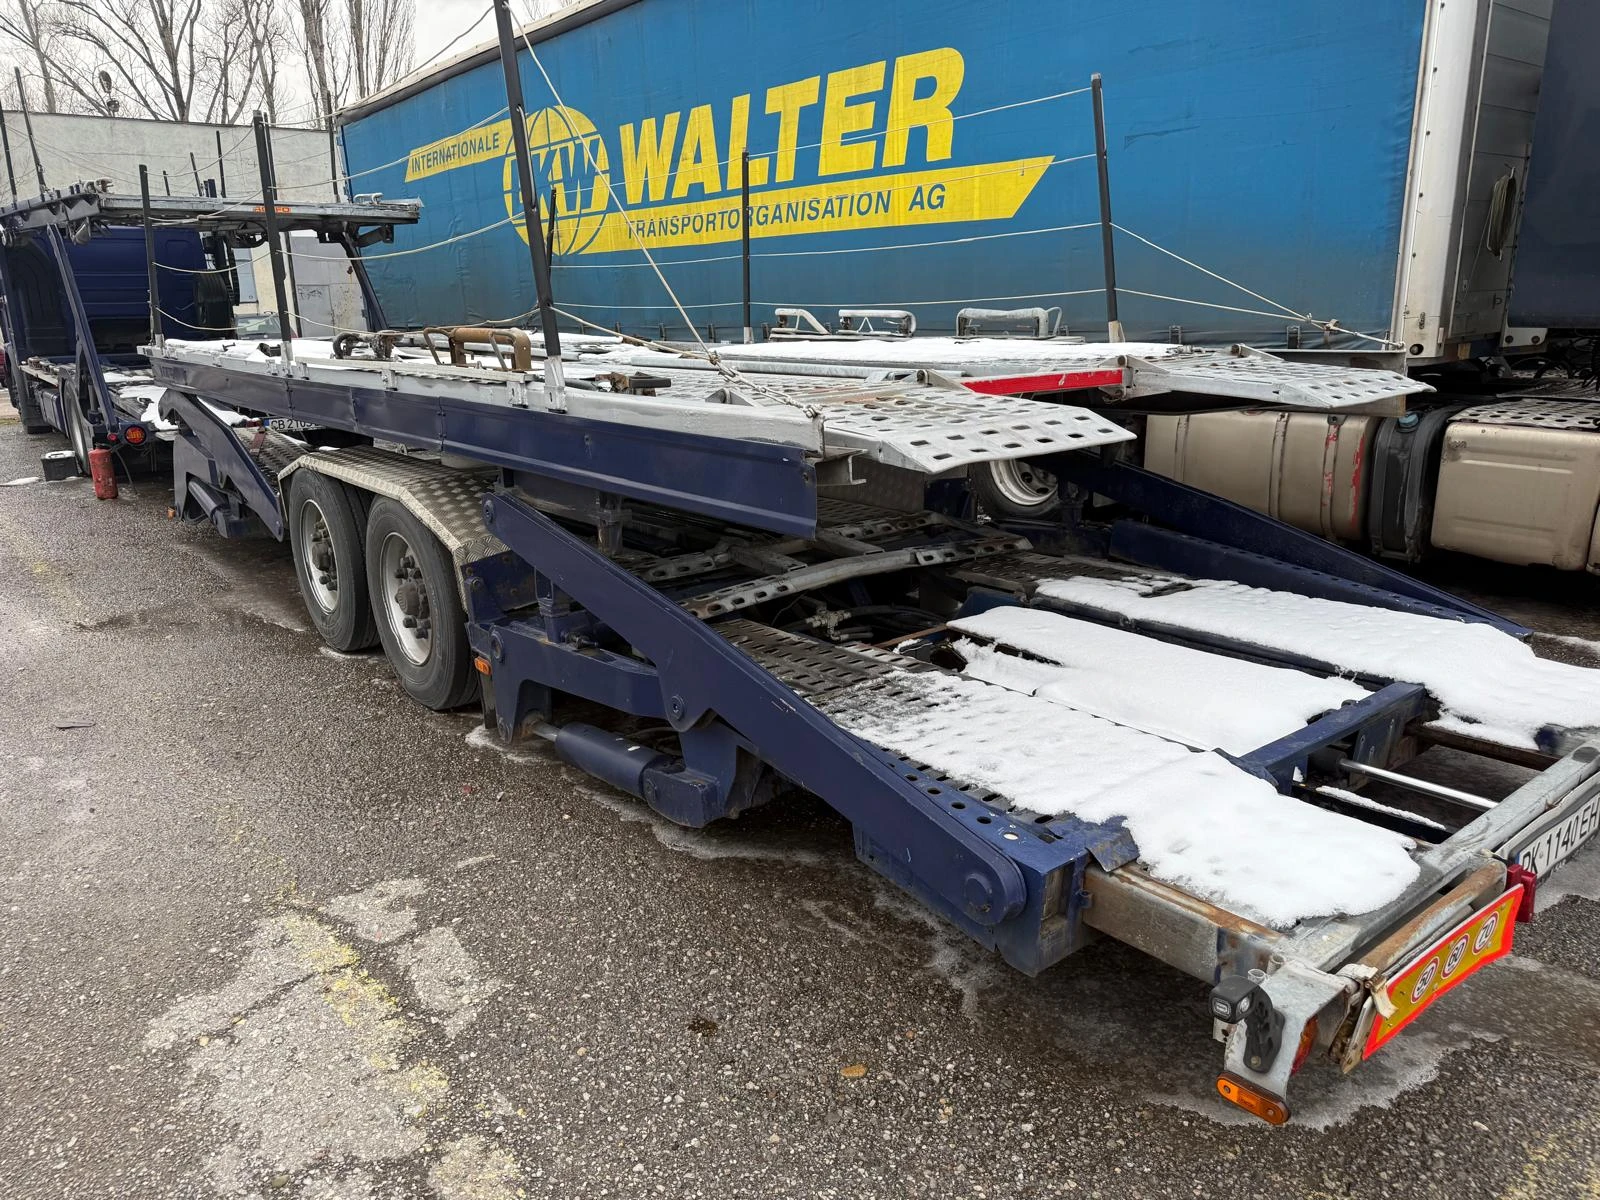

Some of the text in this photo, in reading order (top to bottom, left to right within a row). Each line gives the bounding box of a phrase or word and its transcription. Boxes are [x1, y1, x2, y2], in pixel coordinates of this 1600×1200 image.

[411, 132, 500, 174] INTERNATIONALE
[618, 47, 965, 205] WALTER
[626, 183, 947, 240] TRANSPORTORGANISATION AG
[1546, 815, 1579, 866] 1140
